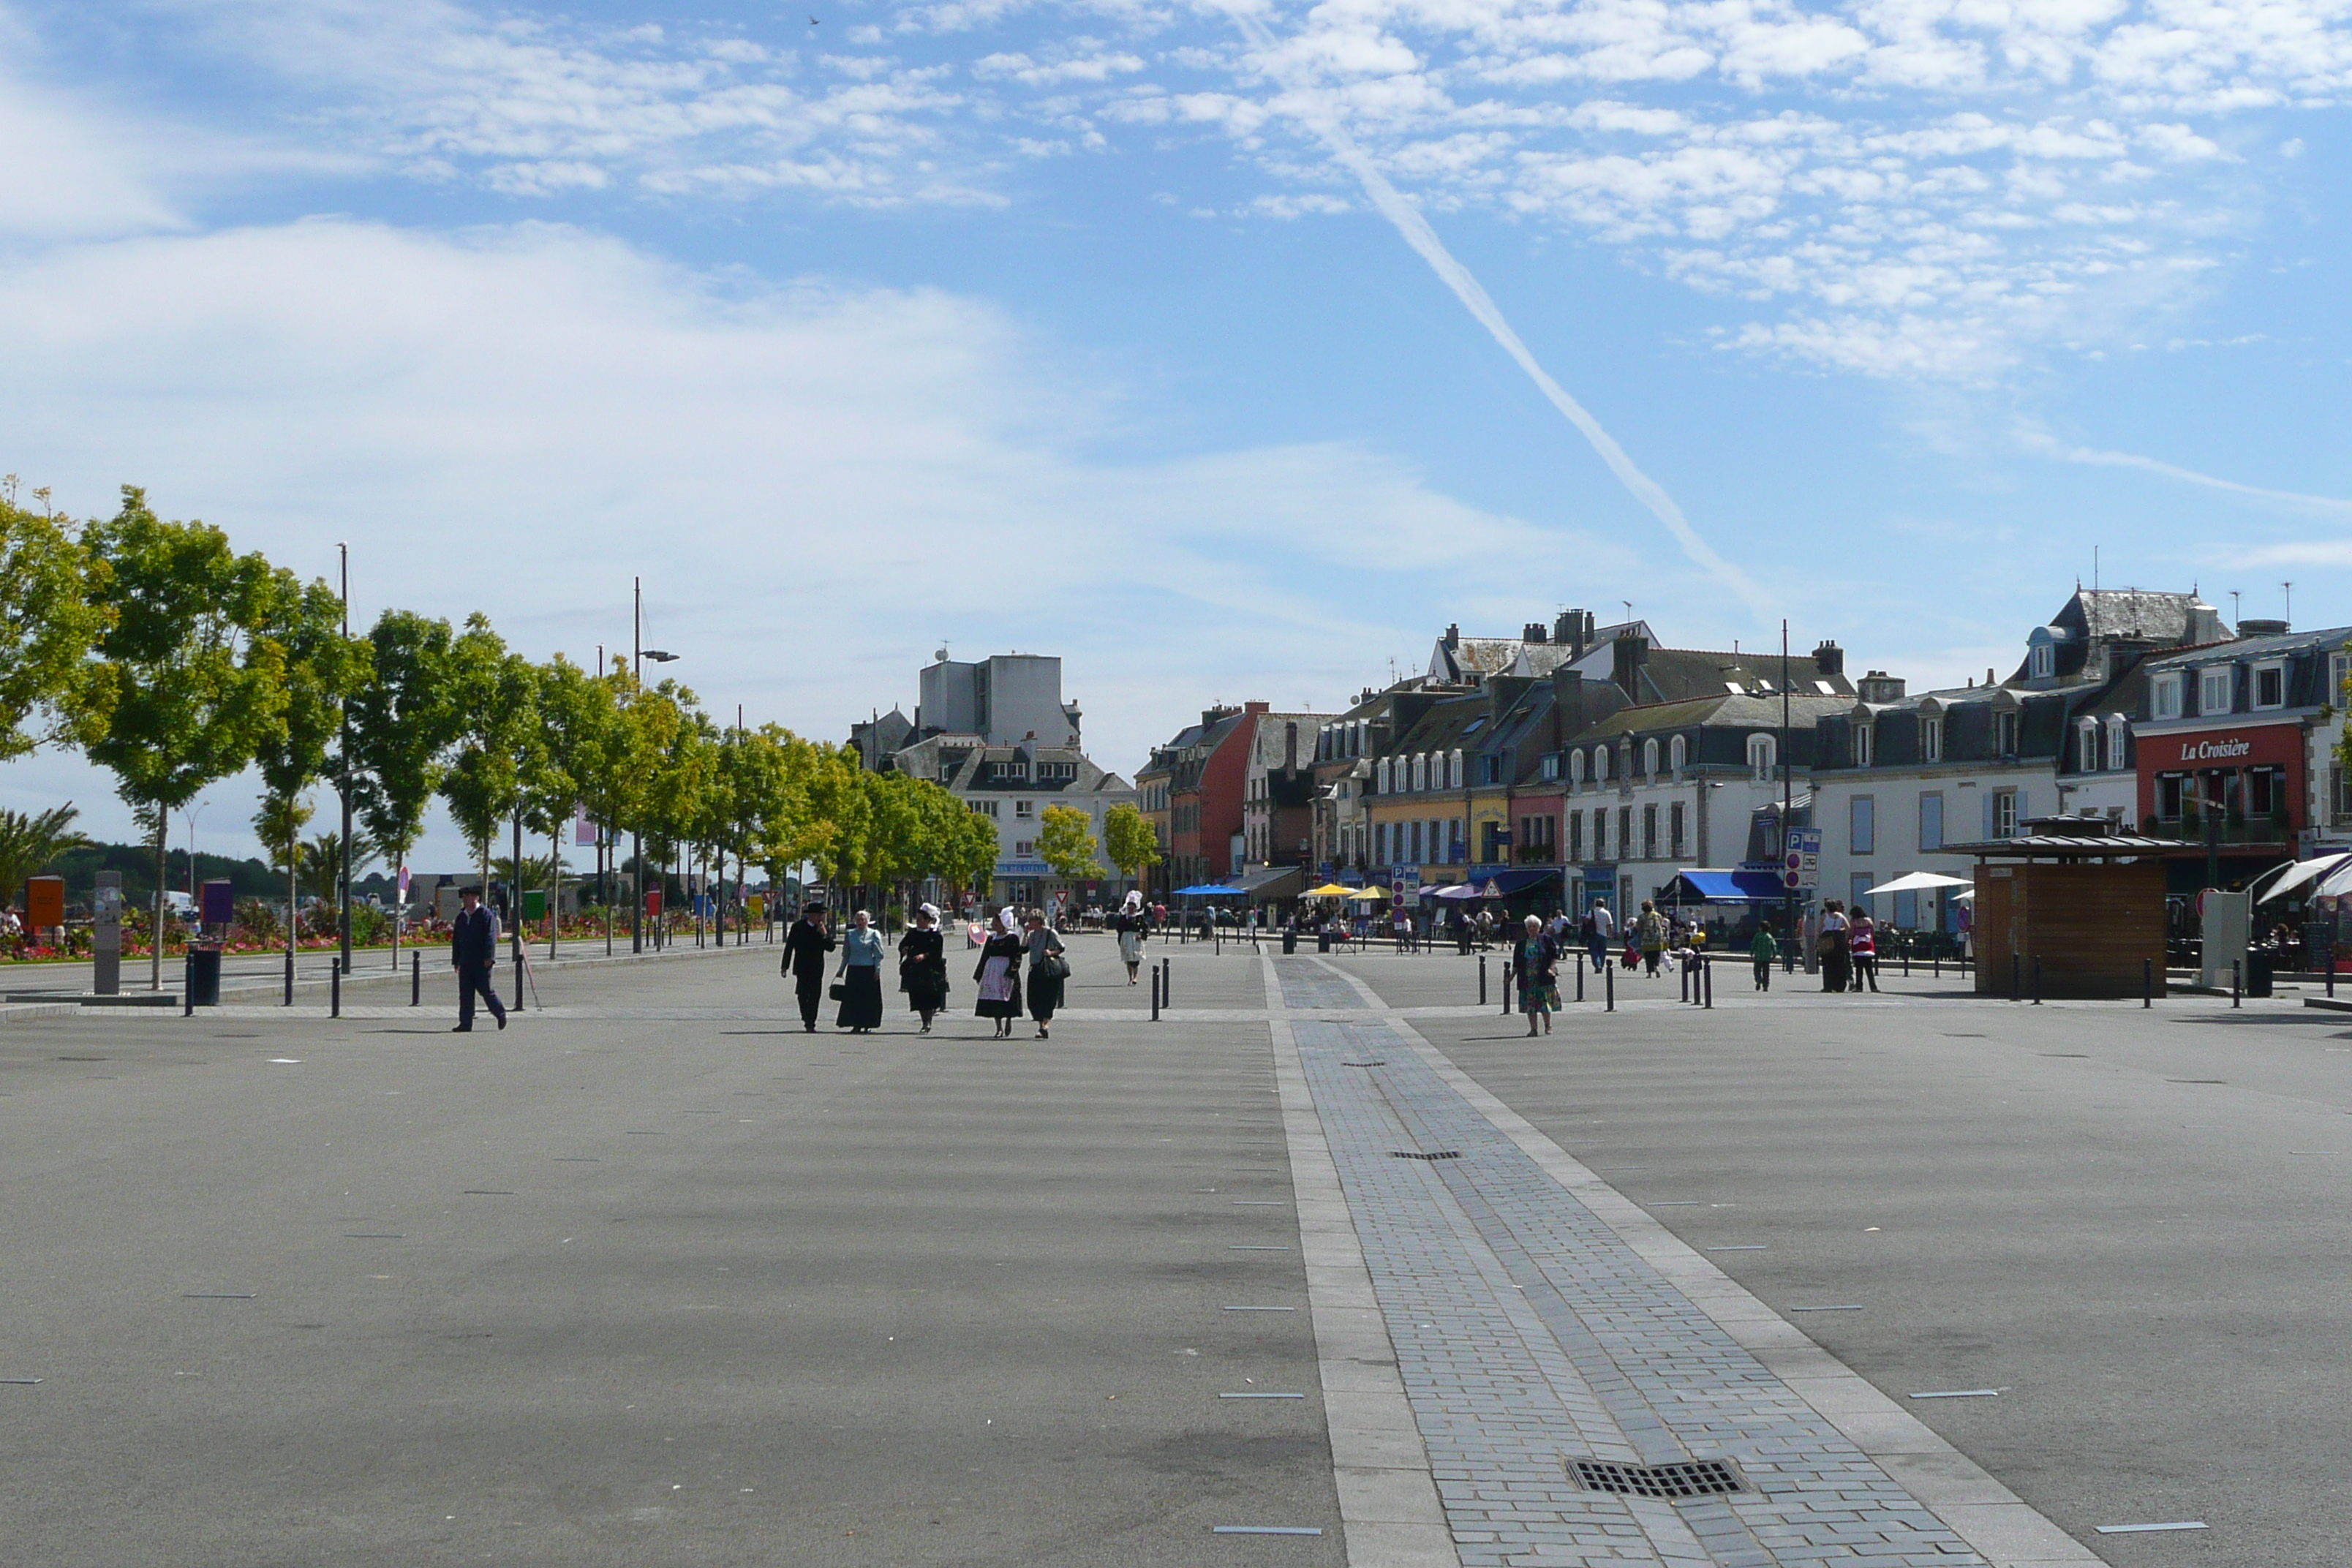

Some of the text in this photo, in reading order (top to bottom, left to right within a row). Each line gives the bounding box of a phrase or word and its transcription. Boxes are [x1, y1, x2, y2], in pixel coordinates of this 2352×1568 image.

[2181, 738, 2250, 761] La Croisière
[1790, 834, 1799, 847] P
[1395, 867, 1402, 878] P
